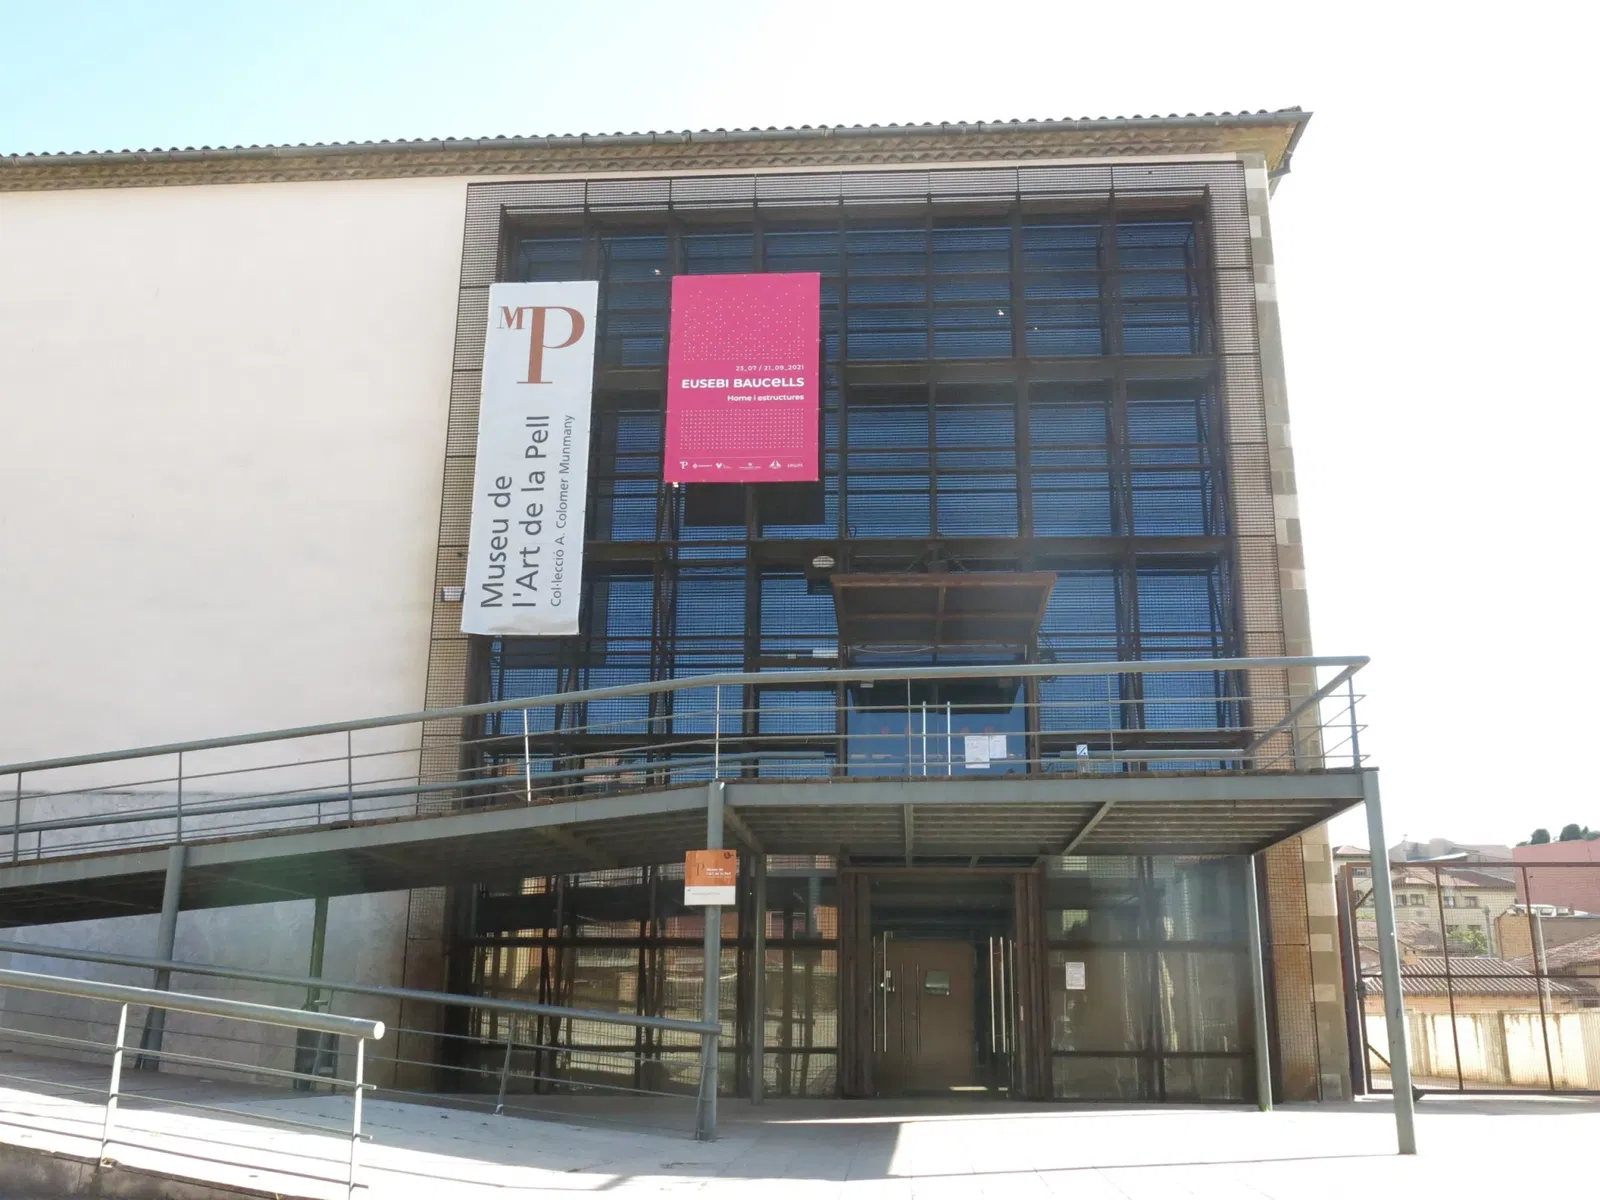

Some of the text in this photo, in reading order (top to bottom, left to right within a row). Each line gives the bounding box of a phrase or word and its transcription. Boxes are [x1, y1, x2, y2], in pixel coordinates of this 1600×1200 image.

[681, 378, 729, 389] EUSEBI
[727, 394, 752, 402] Home
[757, 393, 804, 401] estructures
[558, 414, 576, 474] Munmany
[511, 415, 550, 607] l'Art de la Pell
[555, 478, 570, 529] Colomer
[480, 475, 513, 607] Museu de
[554, 532, 566, 546] A.
